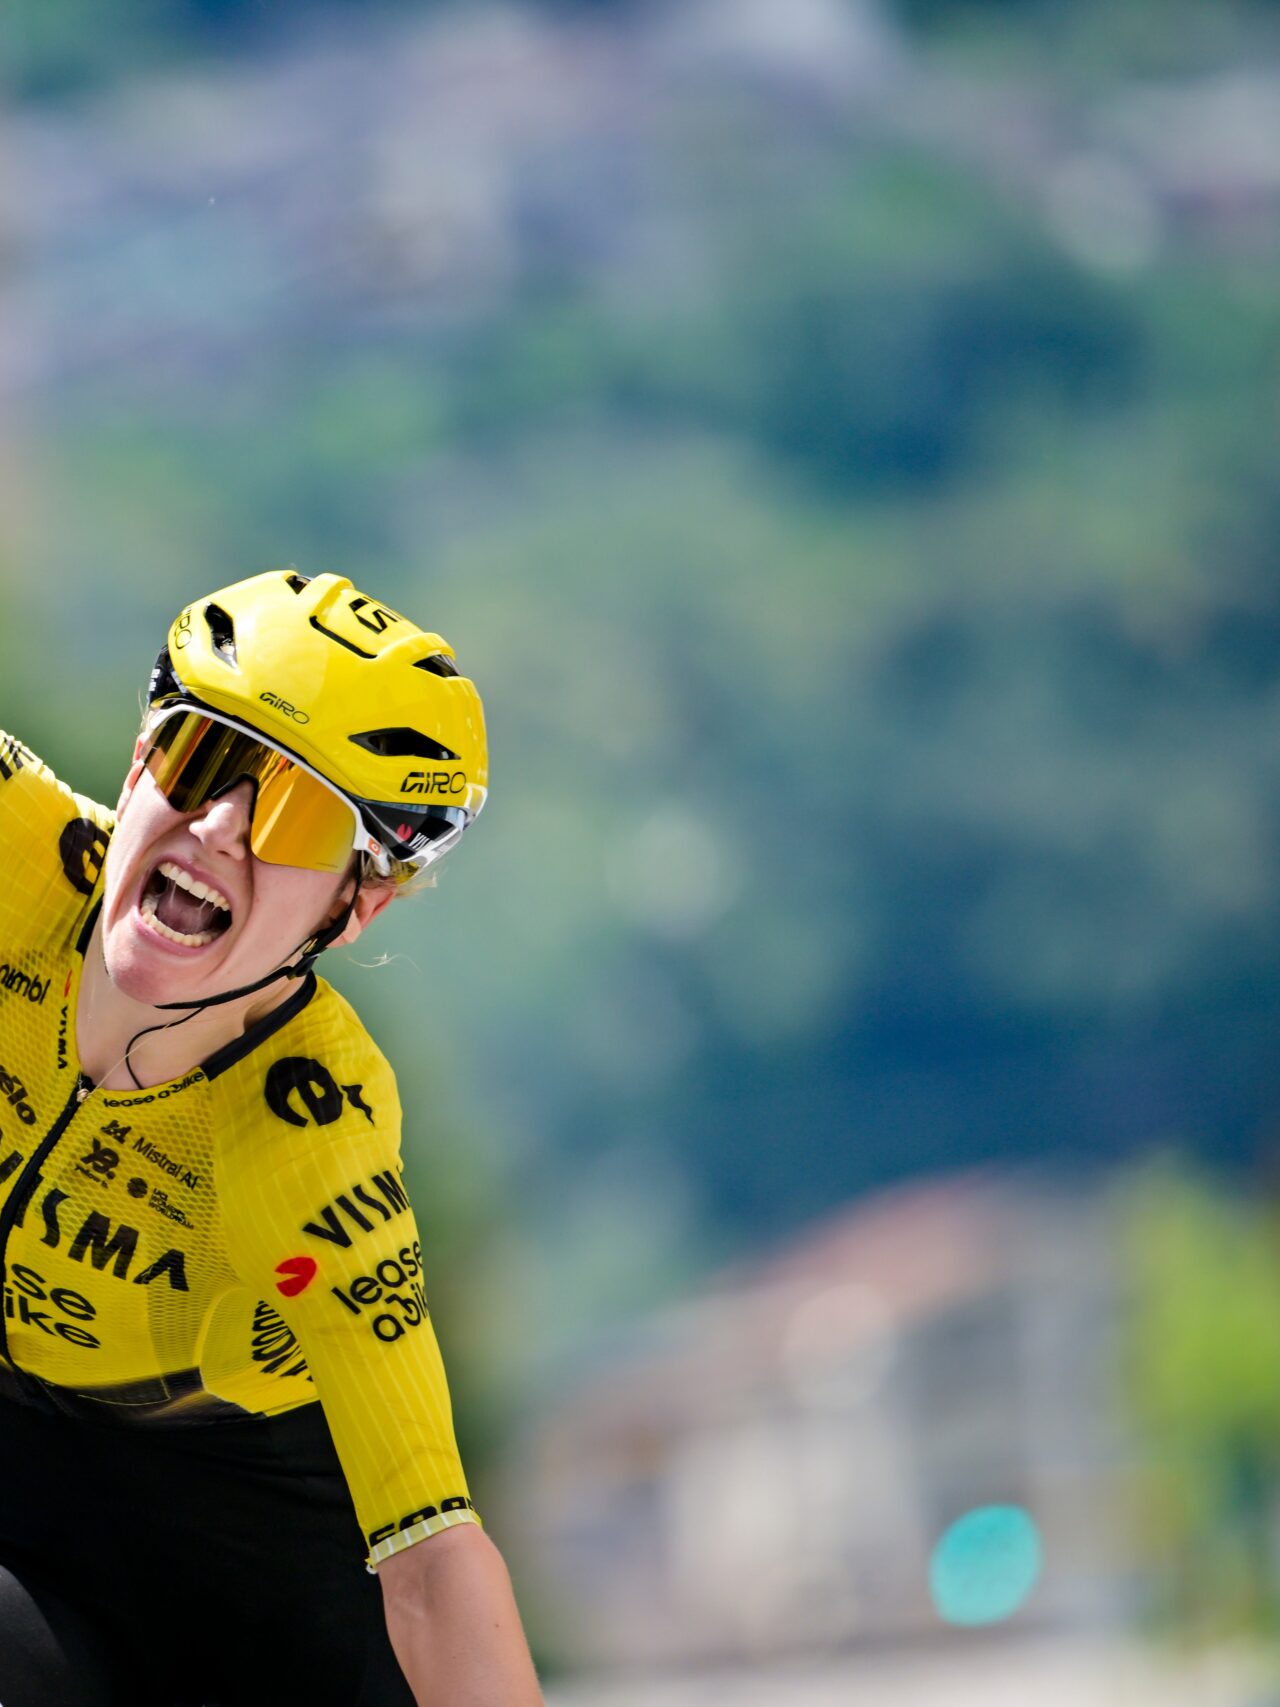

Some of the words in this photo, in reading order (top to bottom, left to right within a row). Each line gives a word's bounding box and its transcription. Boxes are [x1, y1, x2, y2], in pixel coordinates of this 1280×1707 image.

[259, 692, 310, 725] GIRO
[400, 771, 467, 794] GIRO
[103, 1094, 156, 1108] lease
[132, 1137, 183, 1178] Mistral
[179, 1171, 199, 1190] AI
[302, 1166, 411, 1249] VISM
[331, 1241, 423, 1315] lease
